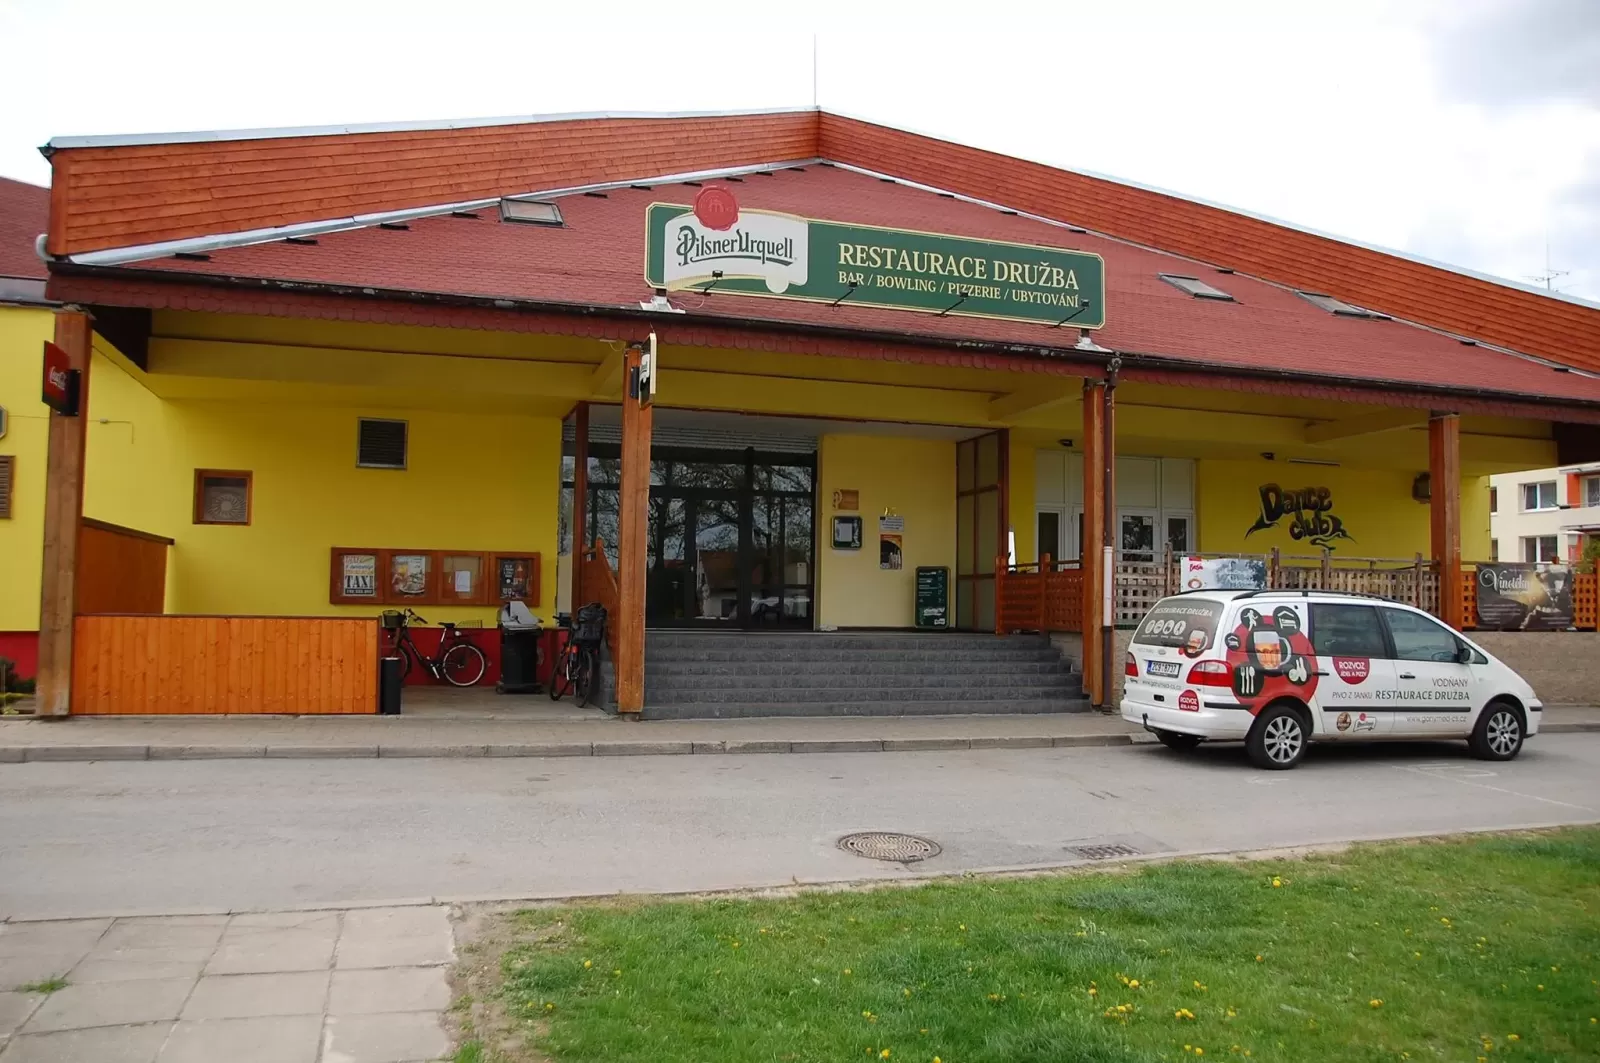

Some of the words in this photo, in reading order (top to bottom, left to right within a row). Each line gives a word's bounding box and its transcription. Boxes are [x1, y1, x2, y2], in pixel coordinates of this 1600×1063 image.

[676, 225, 738, 266] Pilsner
[736, 229, 793, 265] Urquell
[838, 242, 987, 280] RESTAURACE
[993, 260, 1079, 290] DRUŽBA
[838, 271, 864, 286] BAR
[877, 275, 936, 292] BOWLING
[948, 282, 1001, 299] PIZZERIE
[1012, 289, 1079, 308] UBYTOVÁNÍ
[1259, 483, 1332, 521] Dance
[345, 575, 373, 588] TAXI
[1338, 661, 1365, 670] ROZVOZ
[1432, 676, 1468, 687] VODŇANY
[1375, 690, 1432, 700] RESTAURACE
